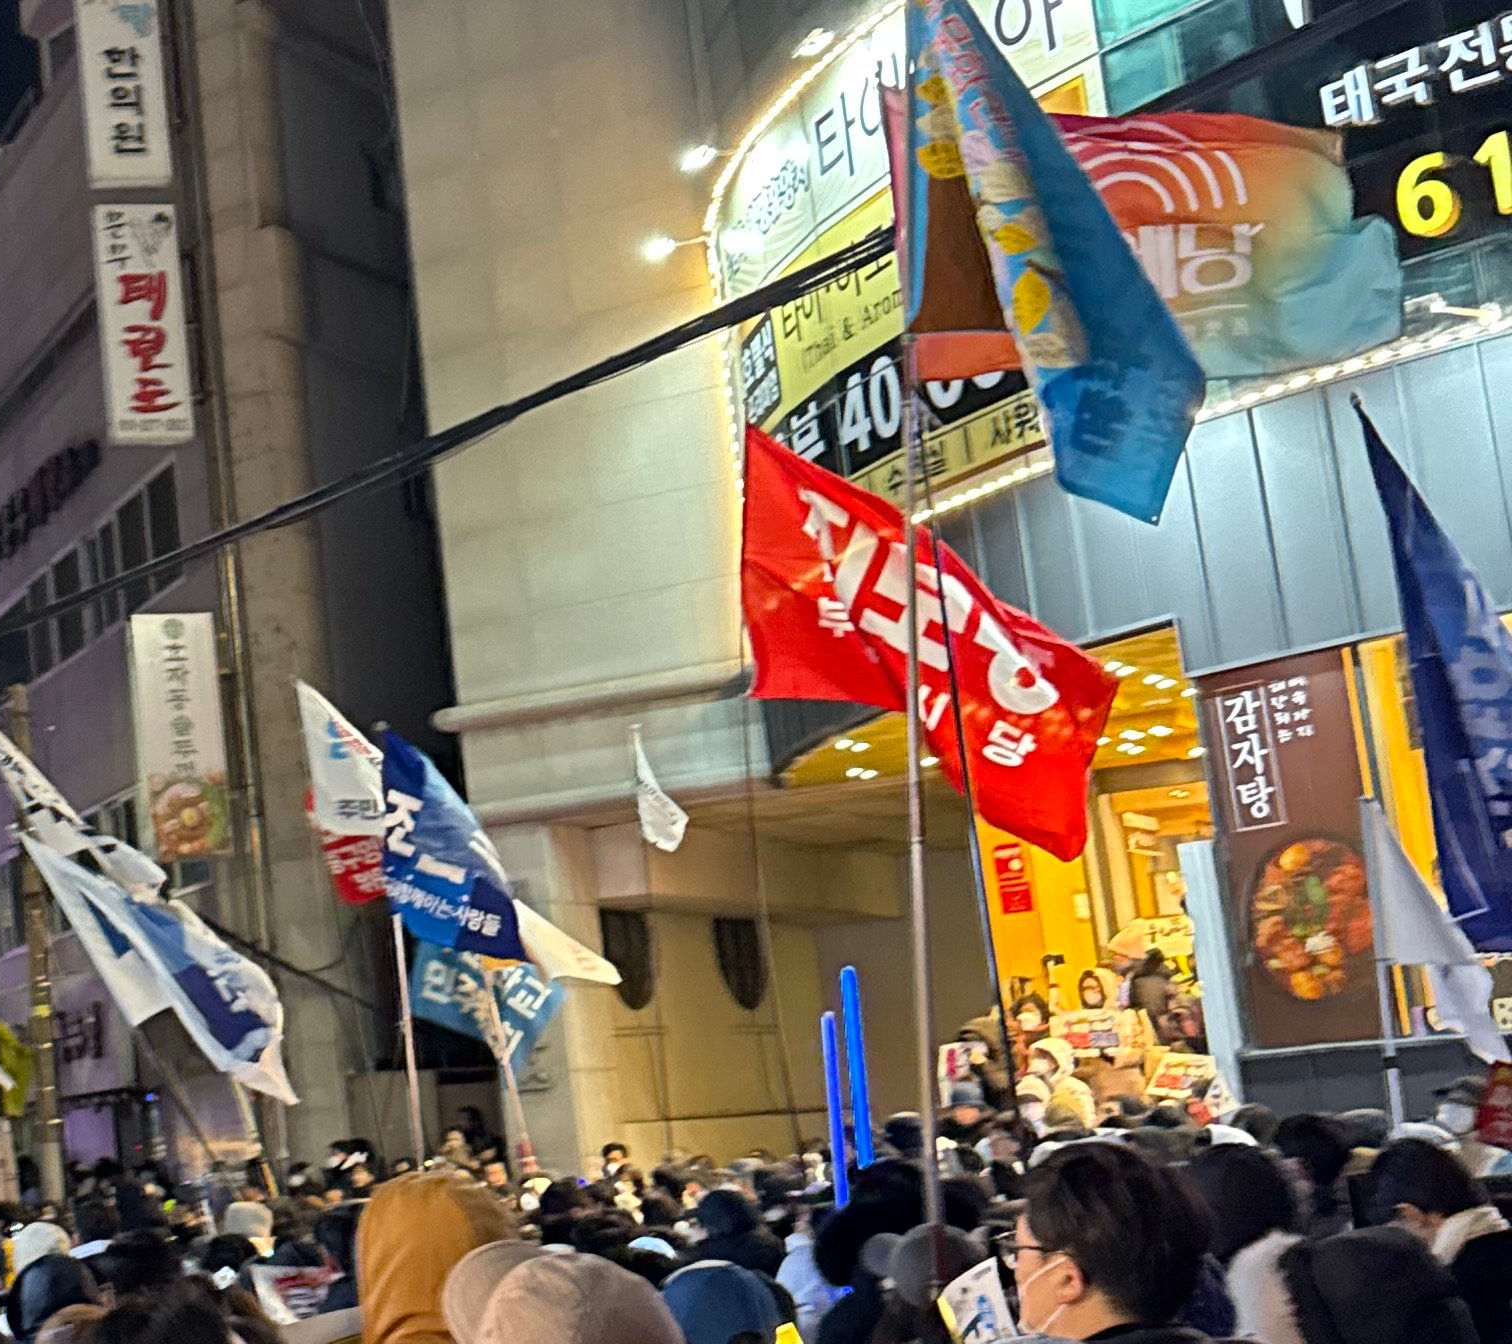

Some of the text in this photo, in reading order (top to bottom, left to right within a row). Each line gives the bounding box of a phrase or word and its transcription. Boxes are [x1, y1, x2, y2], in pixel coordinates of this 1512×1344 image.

[100, 47, 147, 156] 한의원
[1318, 14, 1512, 126] 태국전
[1224, 690, 1276, 820] 감자탕
